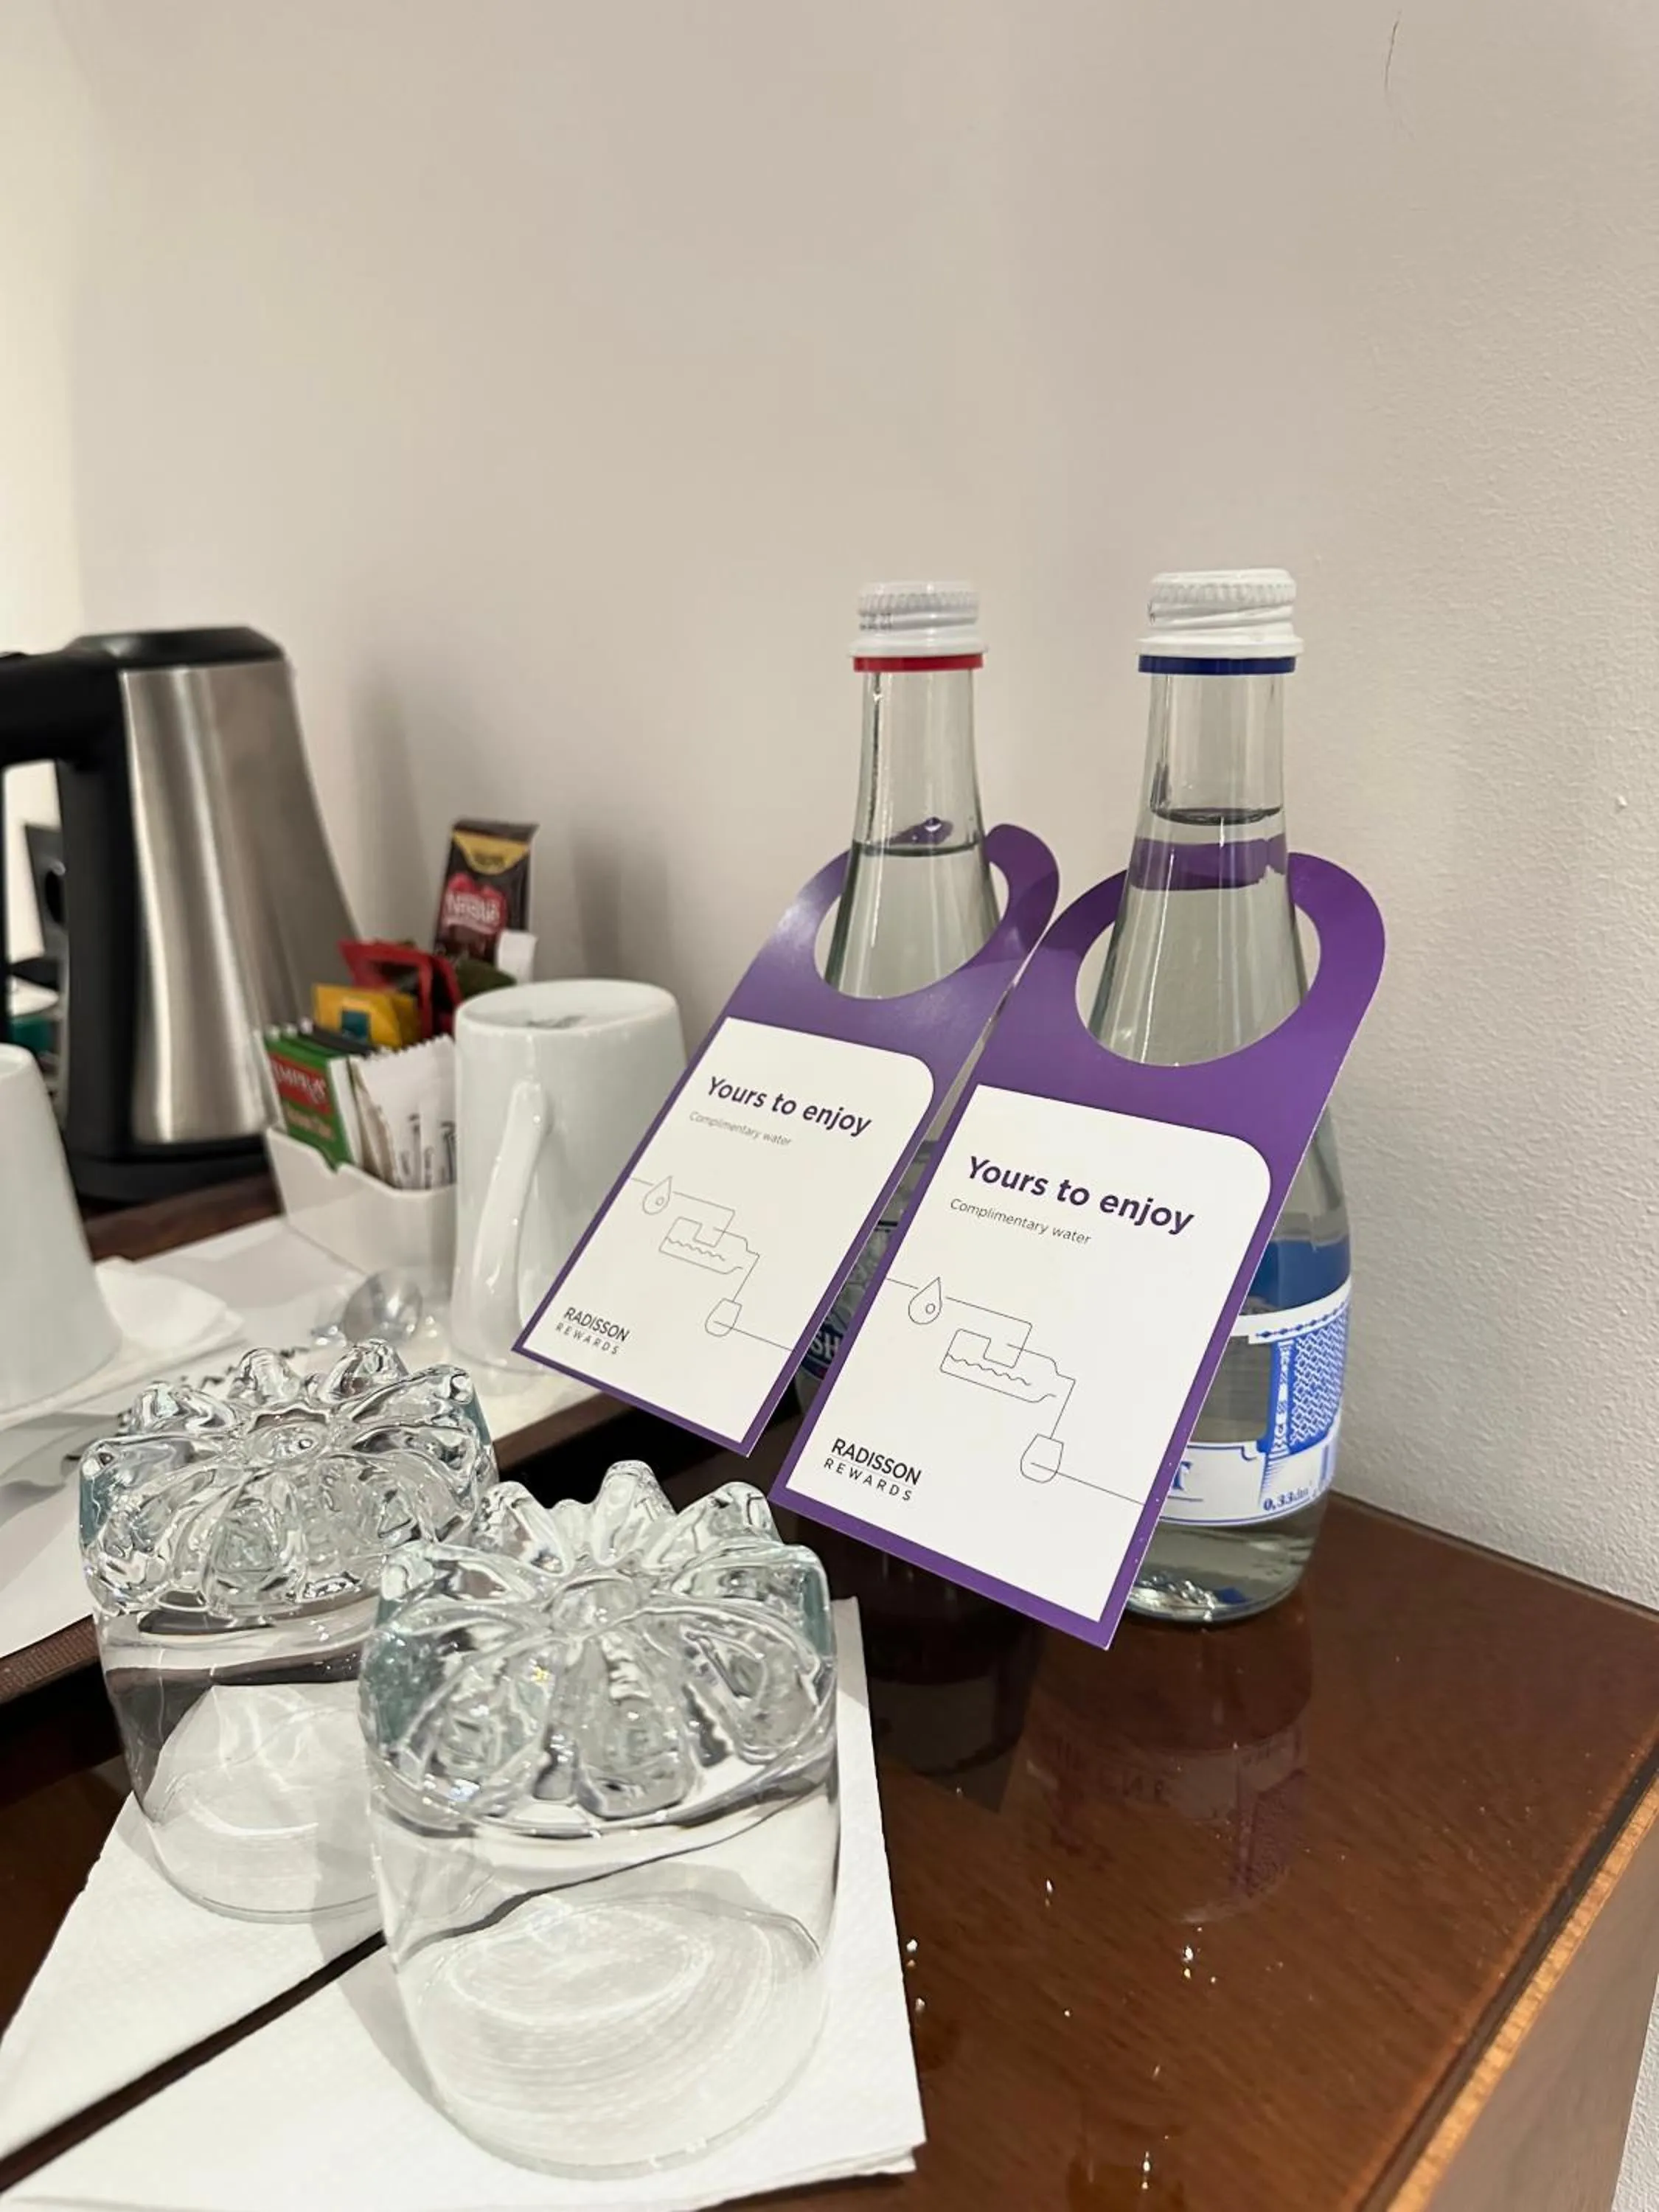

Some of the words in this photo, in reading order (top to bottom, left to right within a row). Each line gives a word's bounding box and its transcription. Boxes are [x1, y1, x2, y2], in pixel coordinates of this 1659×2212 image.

[689, 1110, 762, 1140] Complimentary
[763, 1133, 792, 1147] water
[708, 1076, 768, 1108] Yours
[772, 1093, 798, 1116] to
[802, 1105, 872, 1138] enjoy
[968, 1155, 1049, 1196] Yours
[1057, 1179, 1091, 1206] to
[1099, 1194, 1195, 1236] enjoy
[950, 1198, 1048, 1236] Complimentary
[1051, 1227, 1091, 1245] water
[555, 1321, 619, 1355] REWARDS
[563, 1307, 630, 1342] RADISSON
[824, 1457, 912, 1501] REWARDS
[831, 1437, 922, 1486] RADISSON
